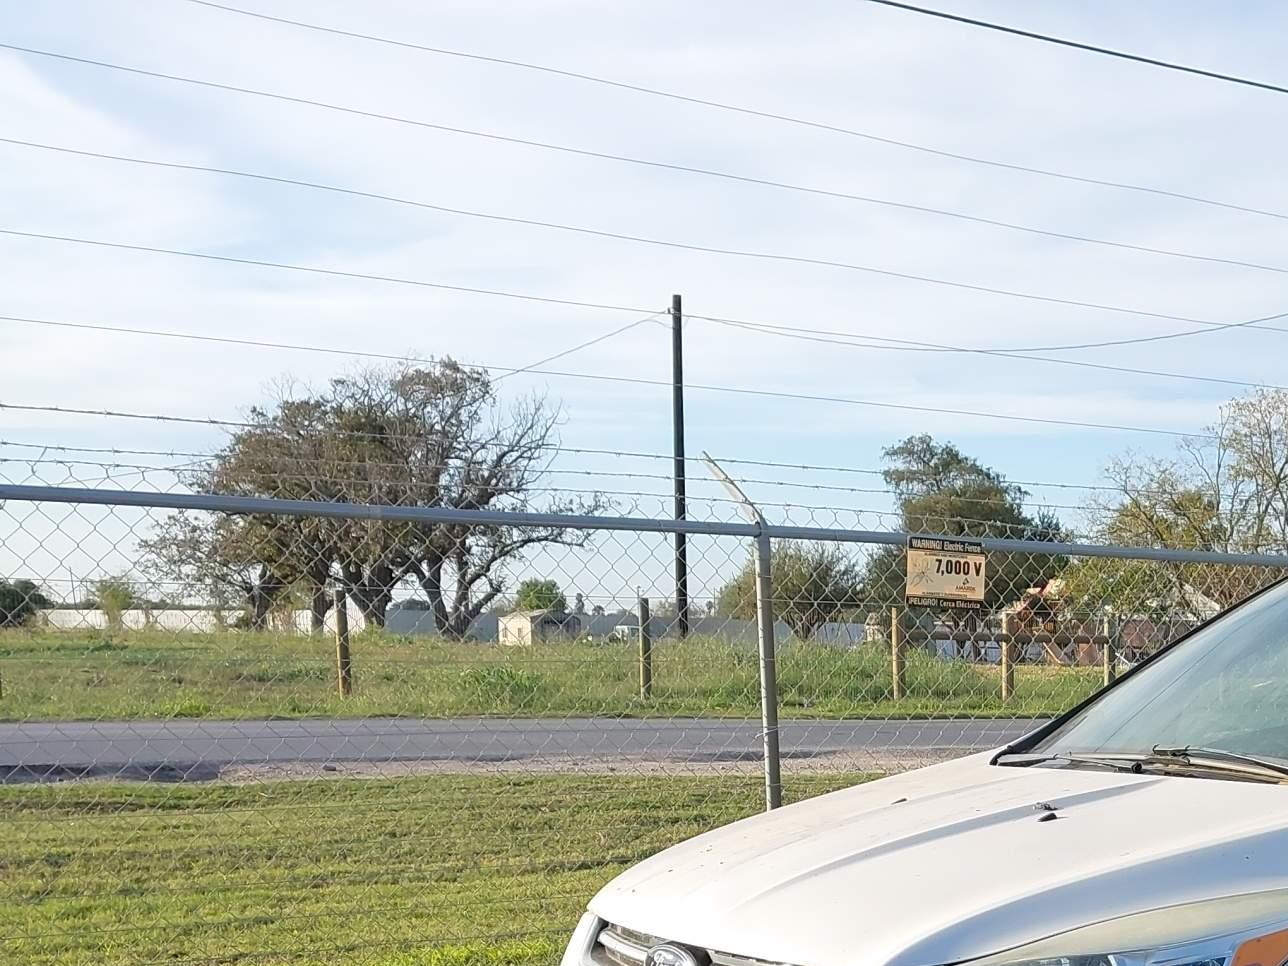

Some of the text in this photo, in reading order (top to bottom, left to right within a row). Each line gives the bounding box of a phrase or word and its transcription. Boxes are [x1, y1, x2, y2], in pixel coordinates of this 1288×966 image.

[911, 538, 981, 553] WARNING! Electric Fence
[935, 558, 982, 577] 7,000 V
[939, 599, 955, 607] Cerca
[955, 600, 981, 609] Eléctrica
